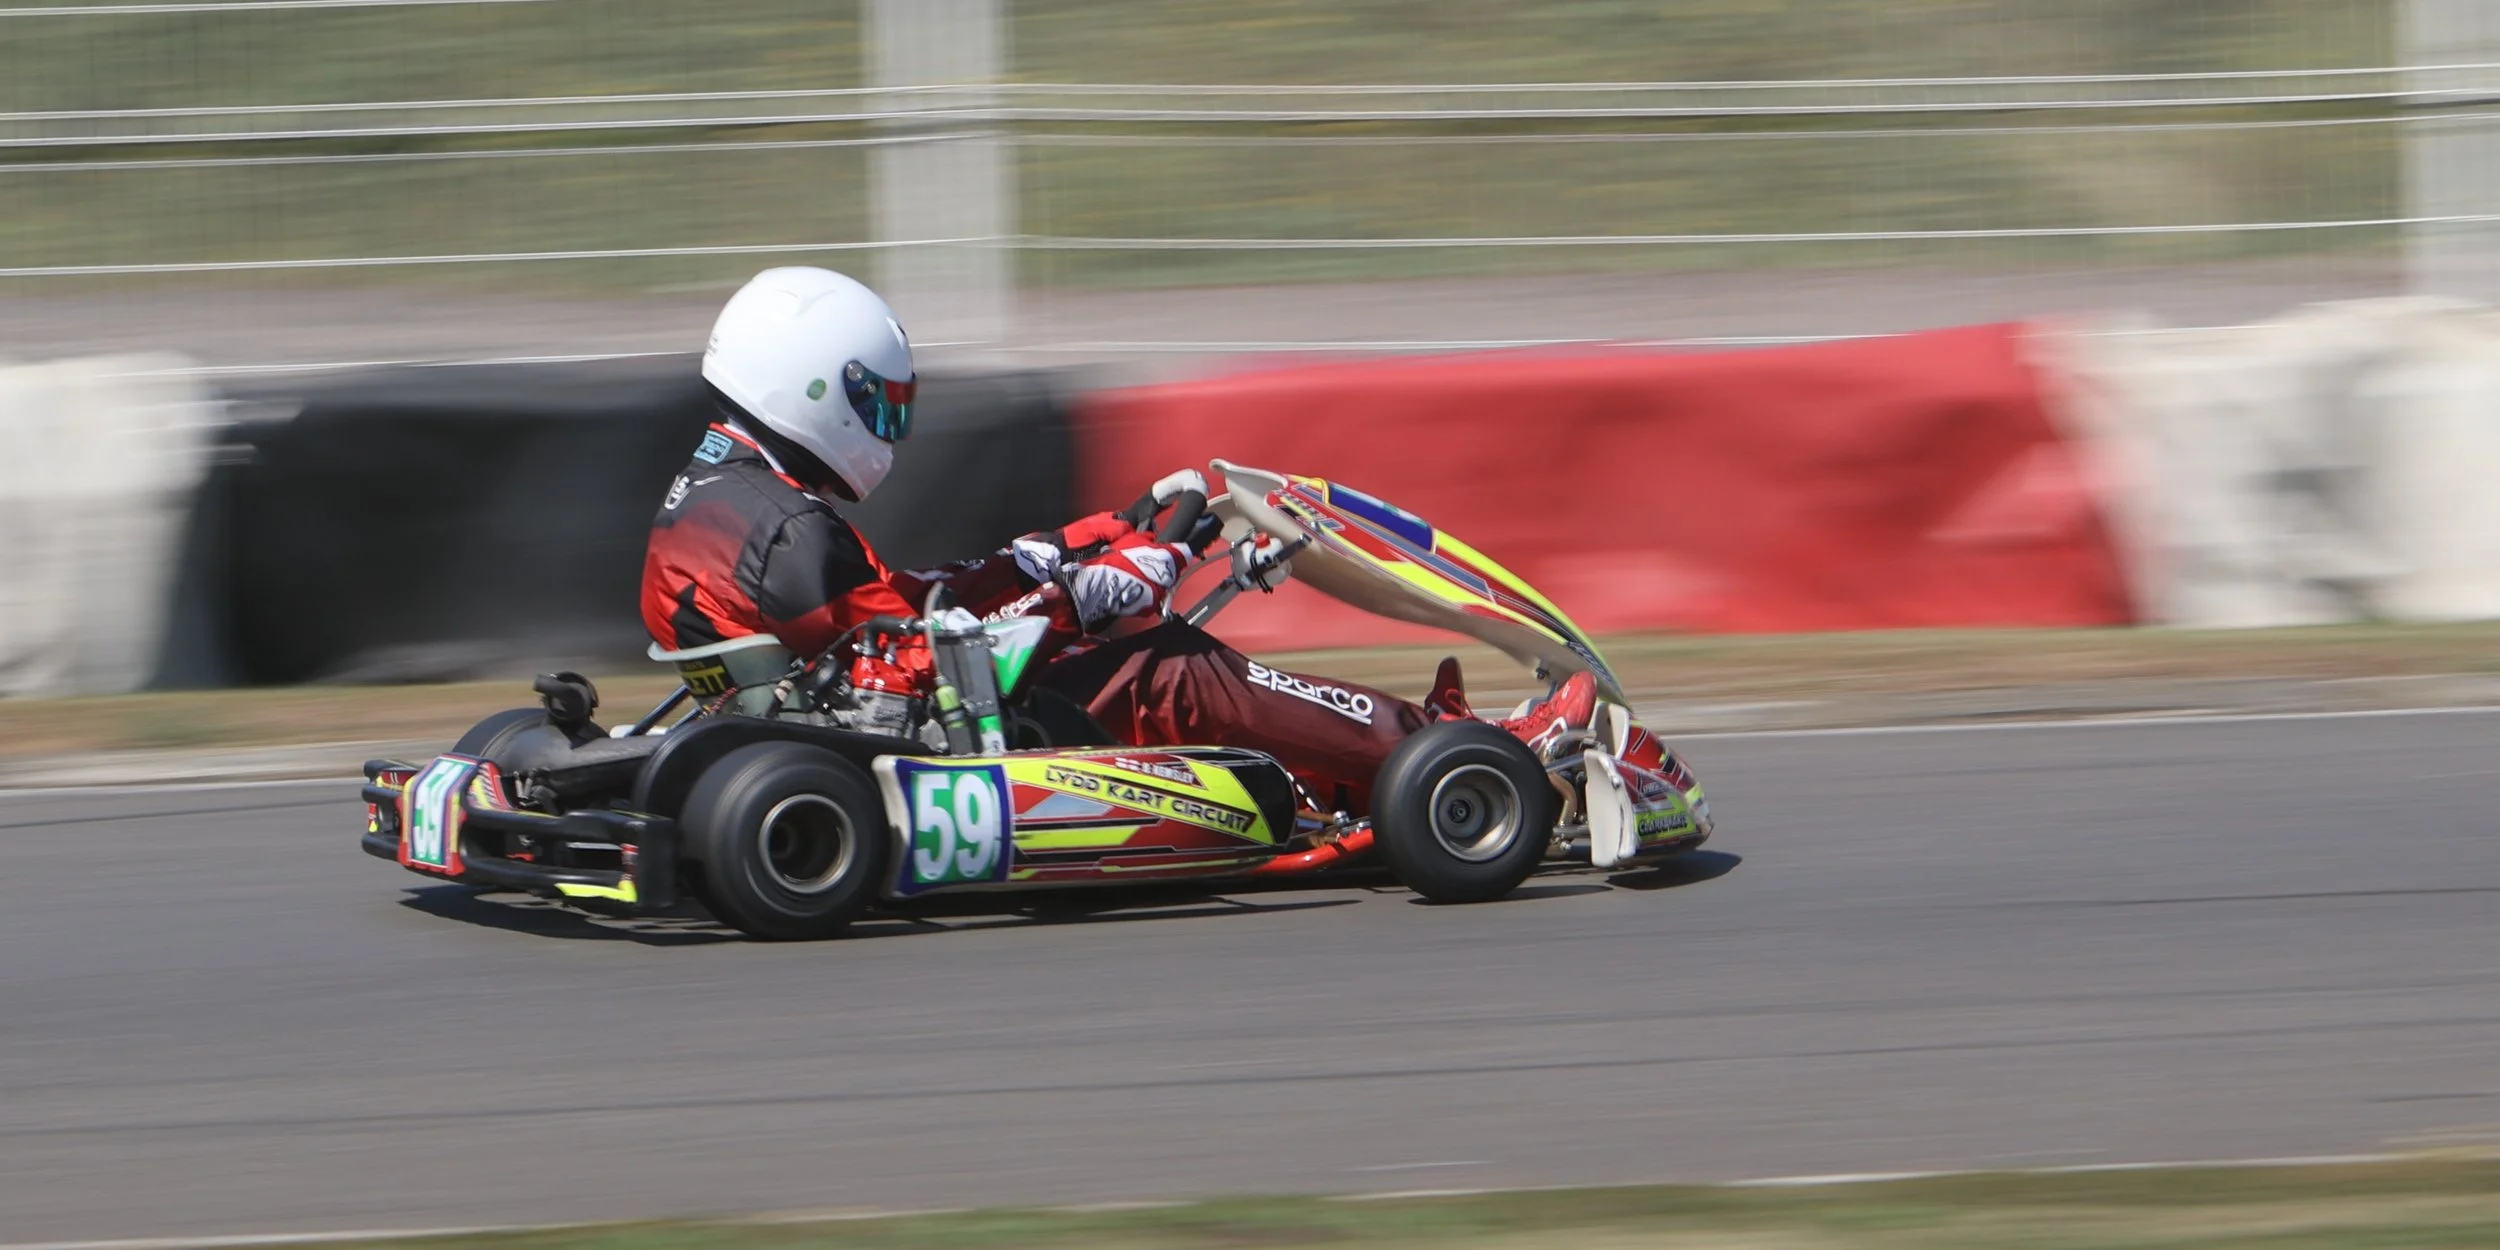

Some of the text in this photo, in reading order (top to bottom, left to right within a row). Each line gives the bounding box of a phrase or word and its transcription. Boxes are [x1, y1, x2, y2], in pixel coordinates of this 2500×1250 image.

[1247, 661, 1373, 724] sparco
[412, 761, 465, 860] 59
[914, 773, 995, 880] 59
[1046, 769, 1100, 791] LYDD
[1107, 781, 1163, 808] KART
[1171, 800, 1249, 832] CIRCUIT
